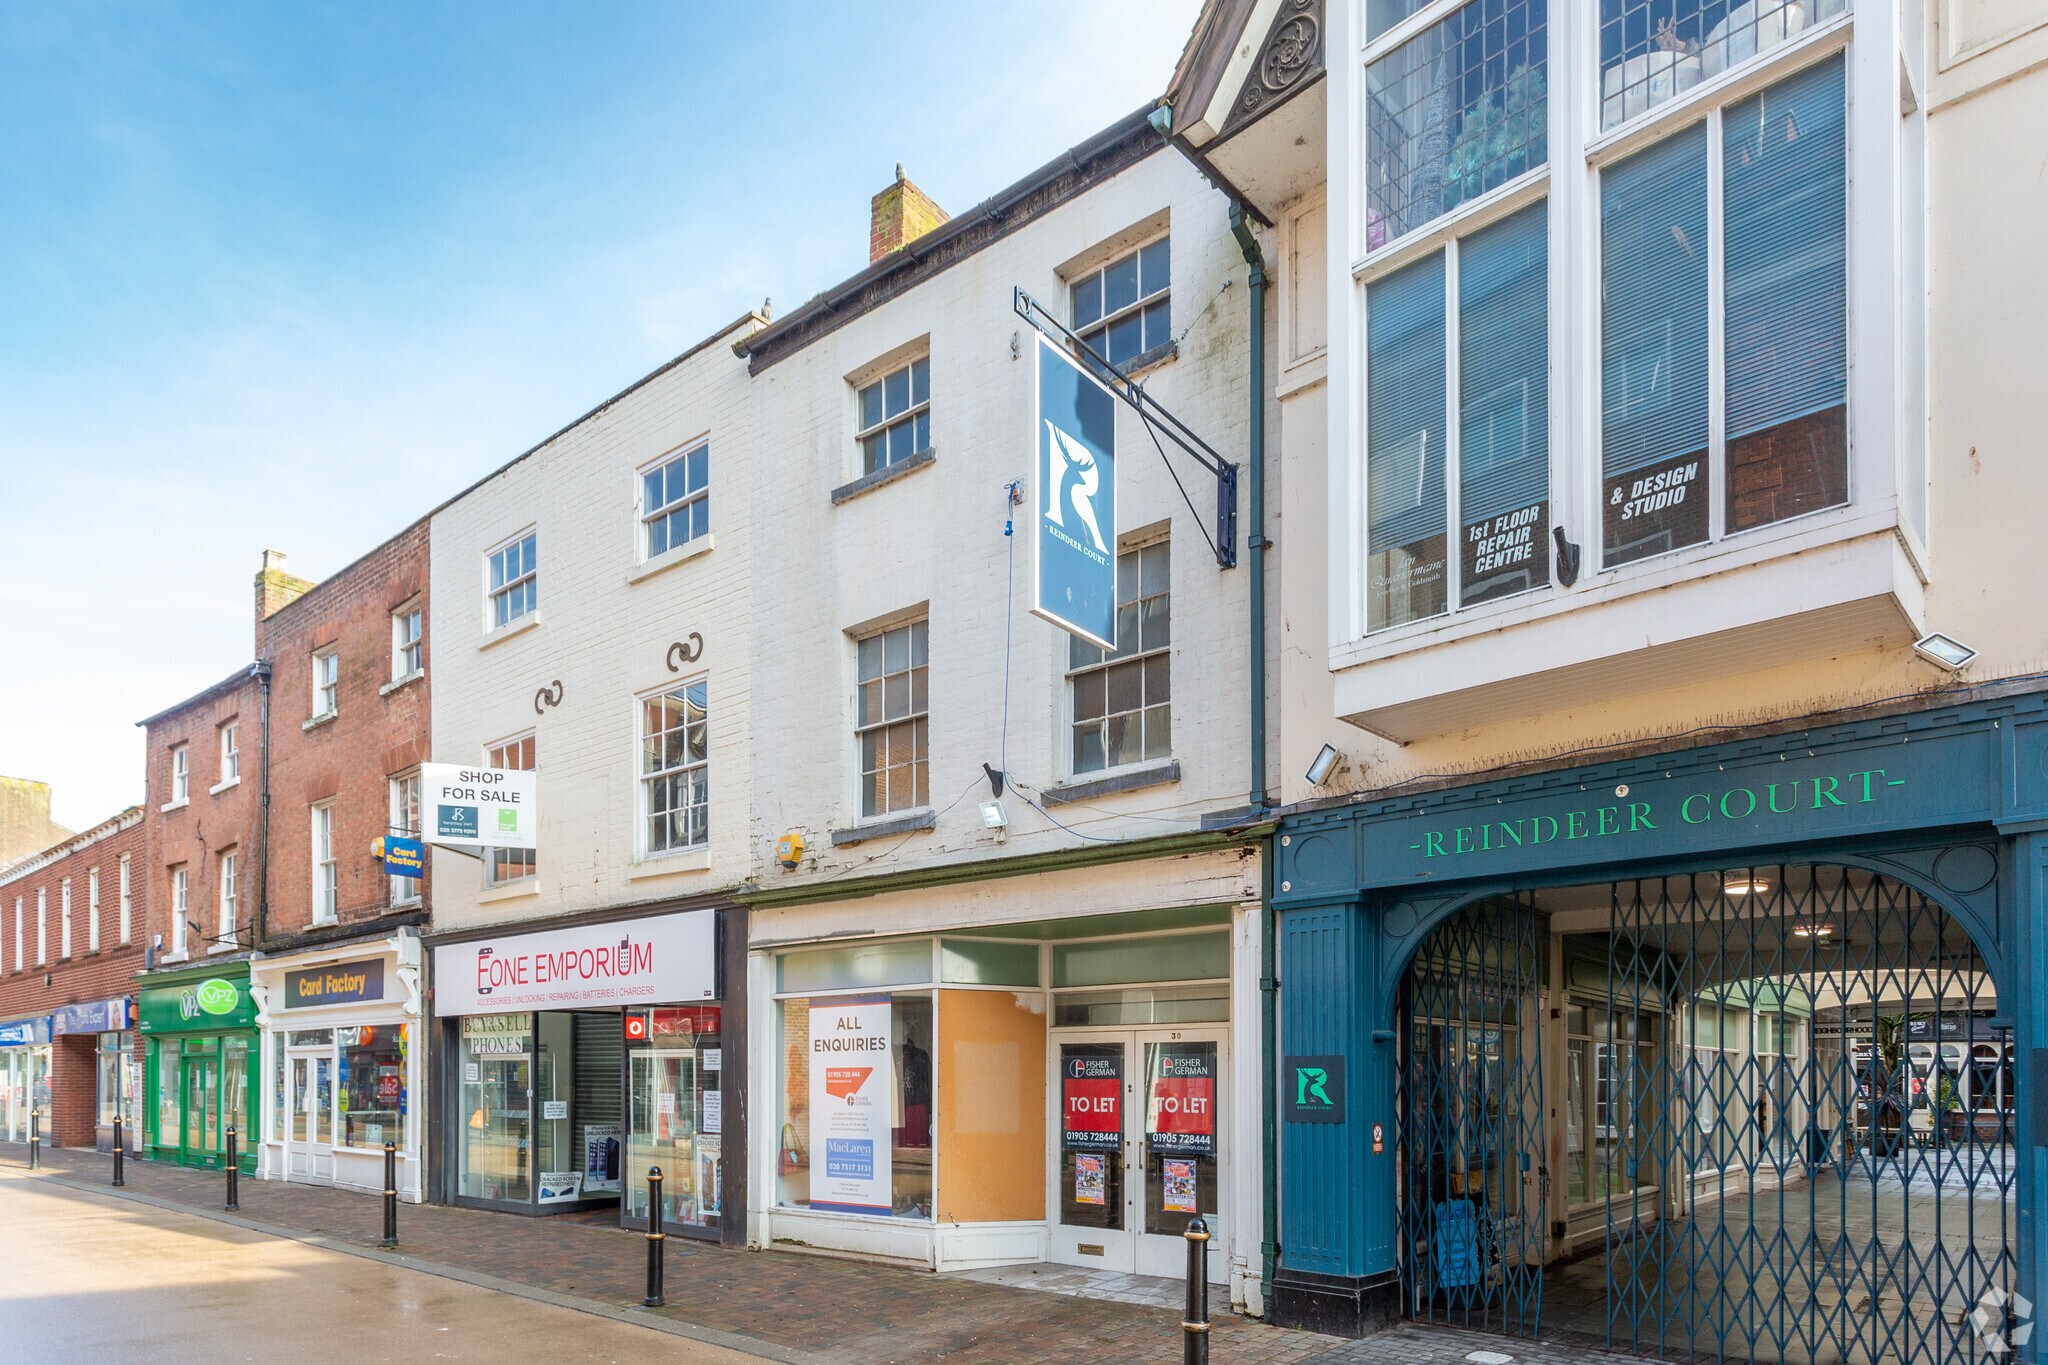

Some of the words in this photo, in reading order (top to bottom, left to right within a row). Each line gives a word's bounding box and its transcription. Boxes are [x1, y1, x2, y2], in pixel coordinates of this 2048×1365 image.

[1611, 487, 1623, 505] &
[1631, 462, 1698, 499] DESIGN
[1622, 486, 1686, 520] STUDIO
[1469, 522, 1490, 541] 1st
[1495, 506, 1539, 533] FLOOR
[1050, 526, 1082, 553] REINDEER
[1084, 547, 1105, 565] COURT
[1477, 526, 1531, 557] REPAIR
[1475, 542, 1533, 574] CENTRE
[1409, 572, 1440, 587] Goldsmith
[460, 771, 504, 784] SHOP
[442, 788, 475, 800] FOR
[481, 790, 521, 803] SALE
[393, 847, 416, 857] Card
[386, 856, 422, 868] Factory
[535, 938, 652, 983] EMPORIUM
[299, 976, 322, 997] Card
[326, 973, 366, 995] Factory
[204, 988, 234, 1003] VPZ
[477, 996, 512, 1006] ACCESSORIES
[515, 994, 545, 1004] UNLOCKING
[549, 991, 579, 1002] REPAIRING
[582, 988, 615, 999] BATTERIES
[620, 986, 655, 996] CHARGERS
[182, 994, 200, 1017] VPZ
[837, 1016, 862, 1030] ALL
[473, 1037, 521, 1053] PHONES
[814, 1037, 886, 1052] ENQUIRIES
[1086, 1060, 1109, 1068] FISHER
[1175, 1058, 1200, 1067] FISHER
[1086, 1068, 1115, 1076] GERMAN
[1175, 1067, 1207, 1075] GERMAN
[1070, 1097, 1090, 1113] TO
[1094, 1097, 1115, 1113] LET
[1154, 1097, 1179, 1113] TO
[1183, 1097, 1207, 1113] LET
[1066, 1132, 1089, 1141] 01905
[1090, 1132, 1118, 1142] 728444
[1153, 1133, 1177, 1143] 01905
[1179, 1134, 1210, 1144] 728444
[828, 1142, 871, 1154] MacLaren
[857, 1164, 871, 1172] 3131
